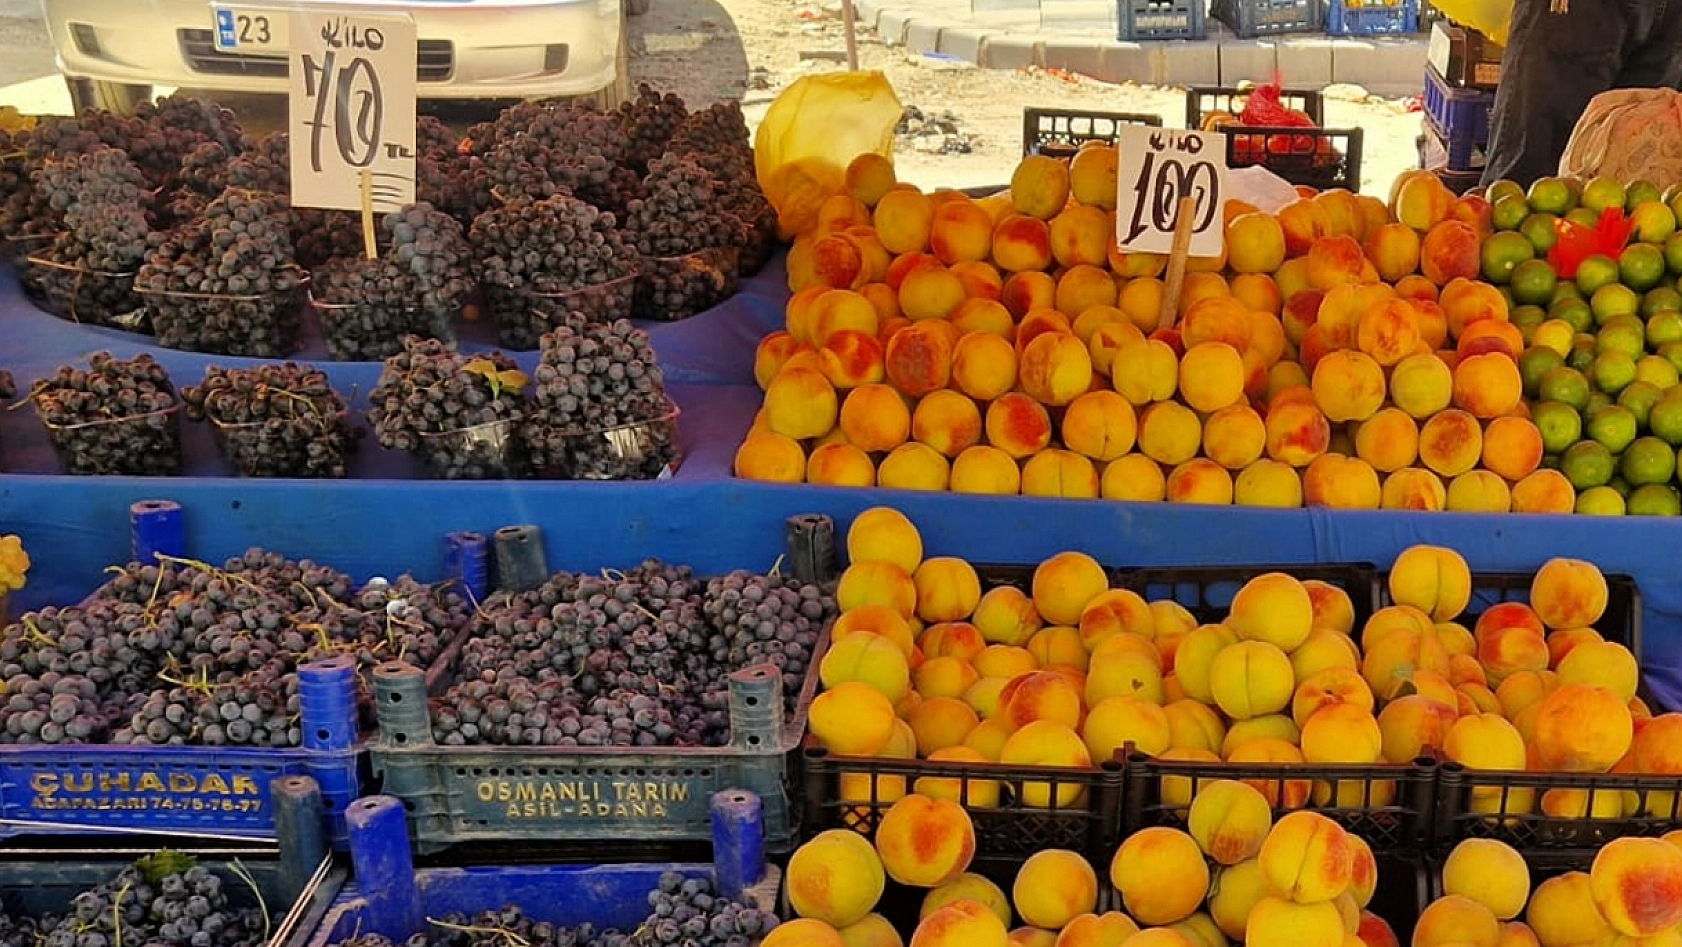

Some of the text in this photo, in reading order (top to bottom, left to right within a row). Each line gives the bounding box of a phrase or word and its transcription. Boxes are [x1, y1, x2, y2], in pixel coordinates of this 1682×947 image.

[237, 15, 271, 43] 23
[302, 51, 382, 171] 70
[1120, 152, 1218, 245] 100
[31, 773, 258, 796] ÇUHADAR
[477, 782, 599, 801] OSMANLI
